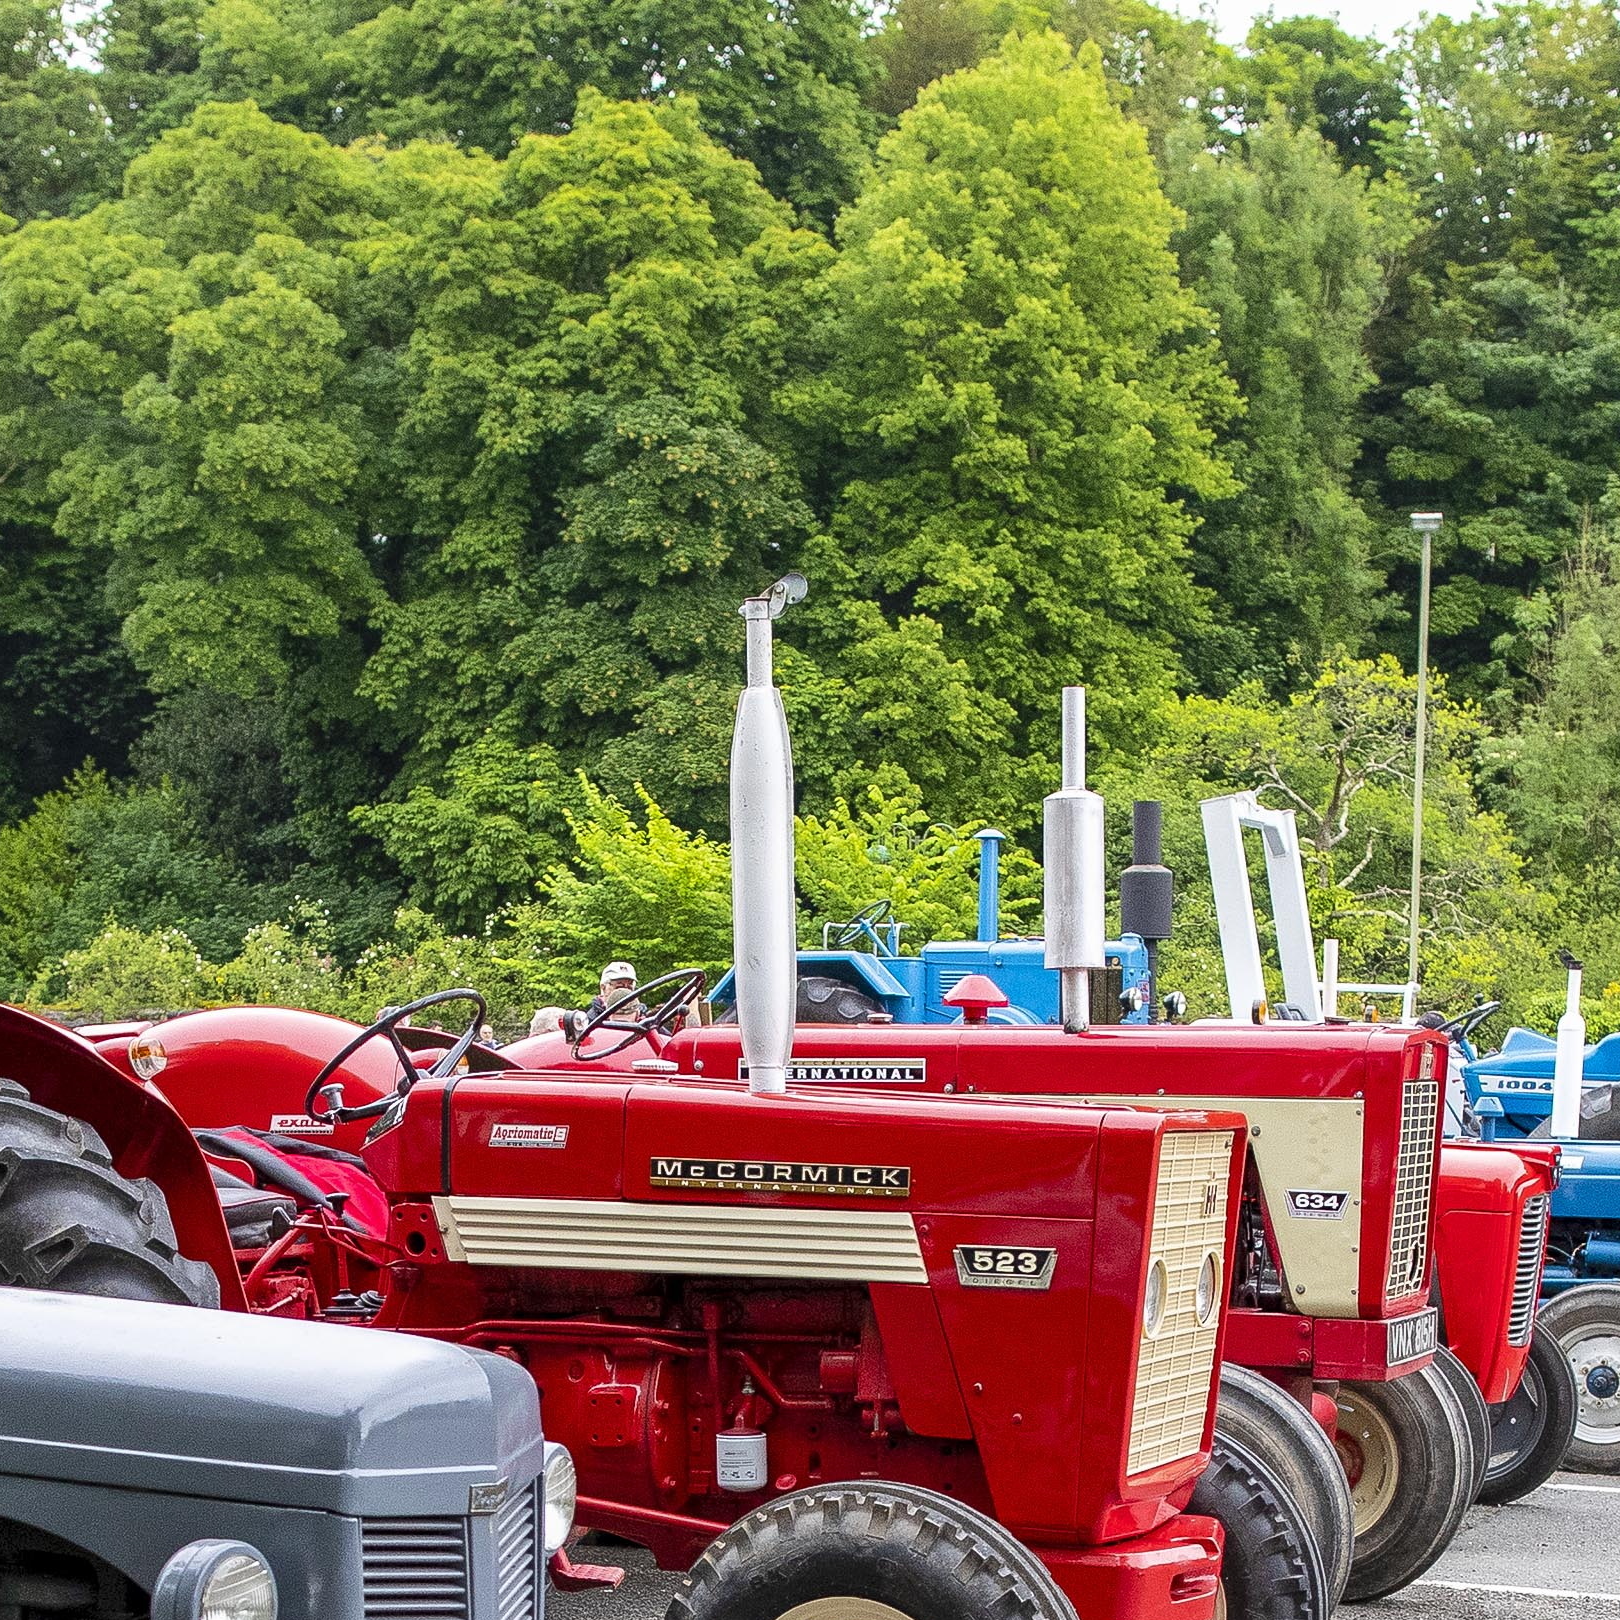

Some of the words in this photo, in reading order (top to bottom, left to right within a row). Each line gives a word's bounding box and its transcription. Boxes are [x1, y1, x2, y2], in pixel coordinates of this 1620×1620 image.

[1498, 1080, 1552, 1091] 1004
[493, 1126, 554, 1140] Agriomatic
[657, 1160, 900, 1185] McCORMICK
[665, 1179, 892, 1195] INTERNATIONAL
[1295, 1193, 1339, 1209] 634
[973, 1250, 1037, 1273] 523
[1391, 1321, 1413, 1359] VNX
